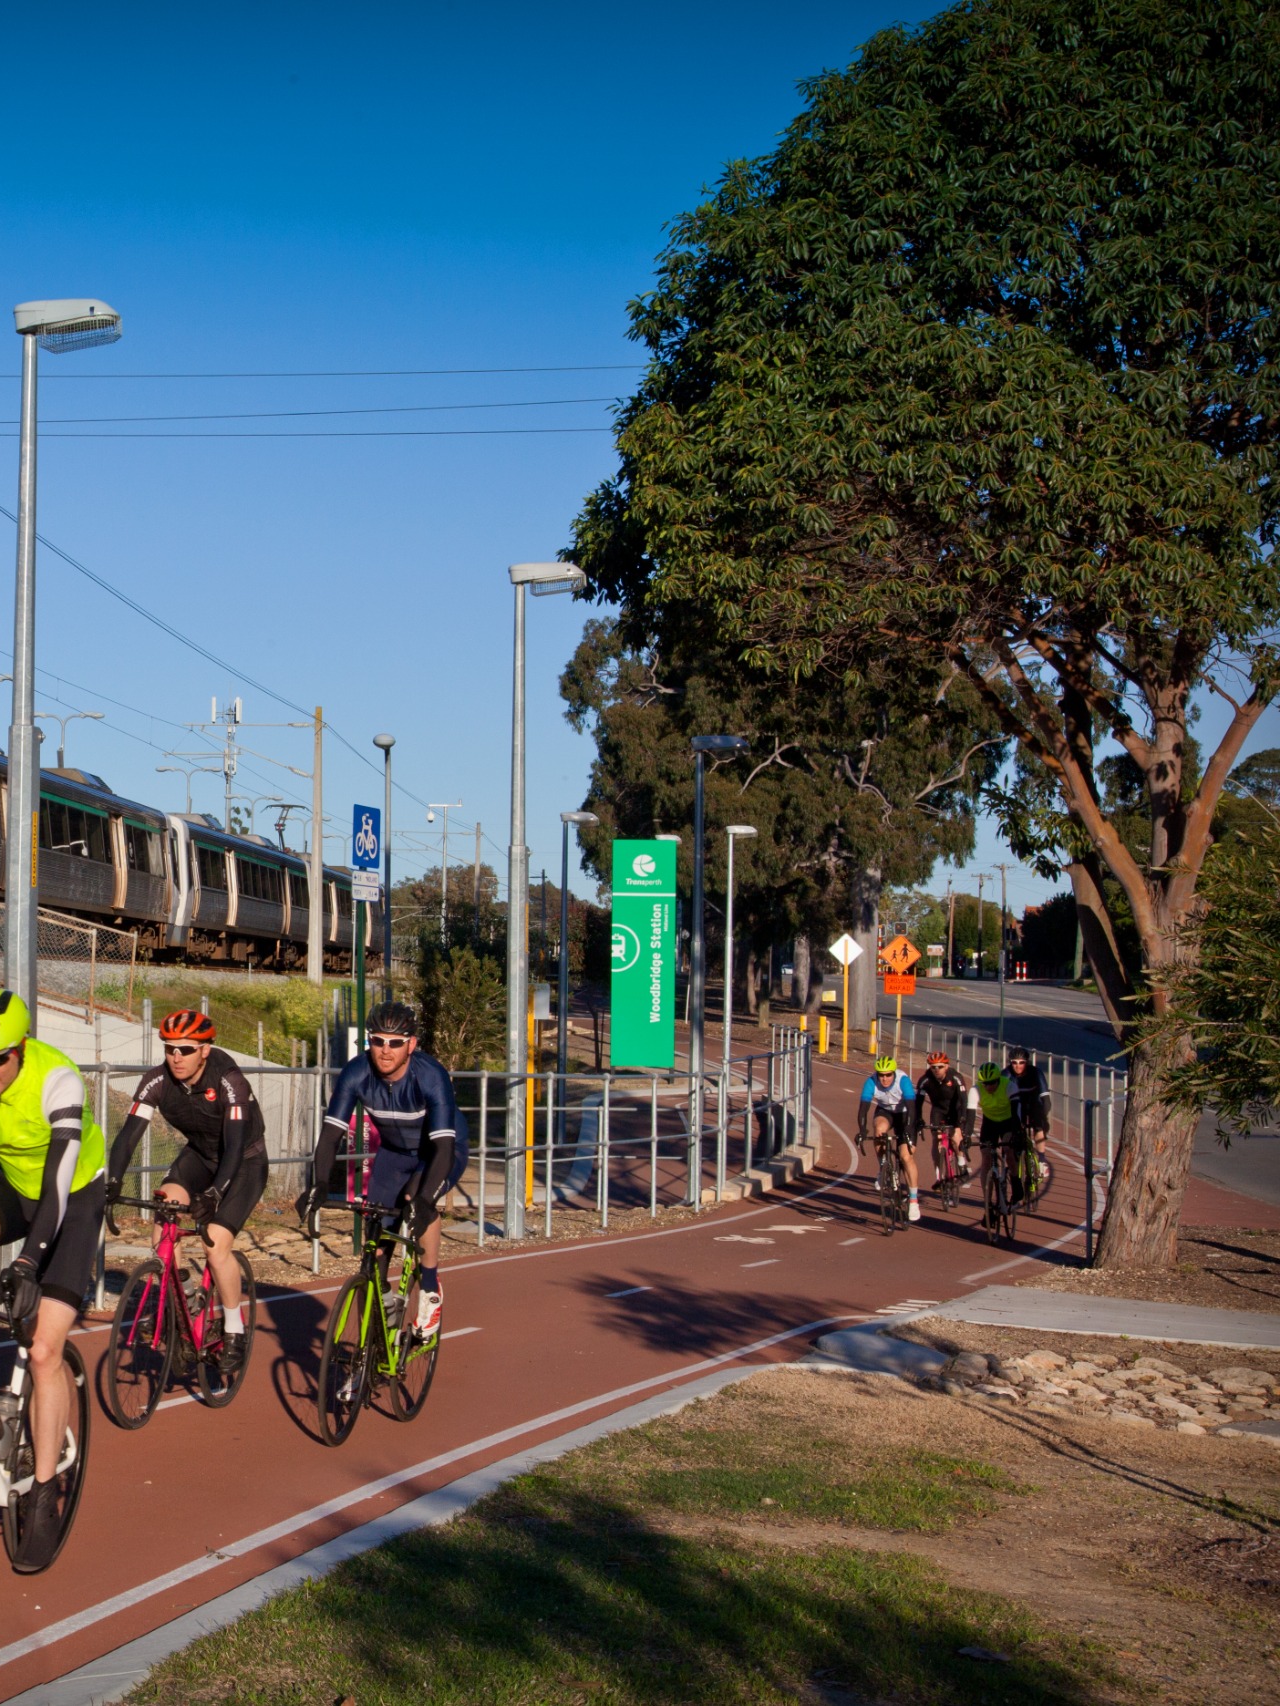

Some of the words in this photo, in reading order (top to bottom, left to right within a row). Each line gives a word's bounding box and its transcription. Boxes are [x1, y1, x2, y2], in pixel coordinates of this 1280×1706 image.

[625, 878, 662, 886] Transperth
[650, 903, 662, 949] Station
[650, 953, 663, 1023] Woodbridge
[363, 1122, 371, 1173] Wodbridge
